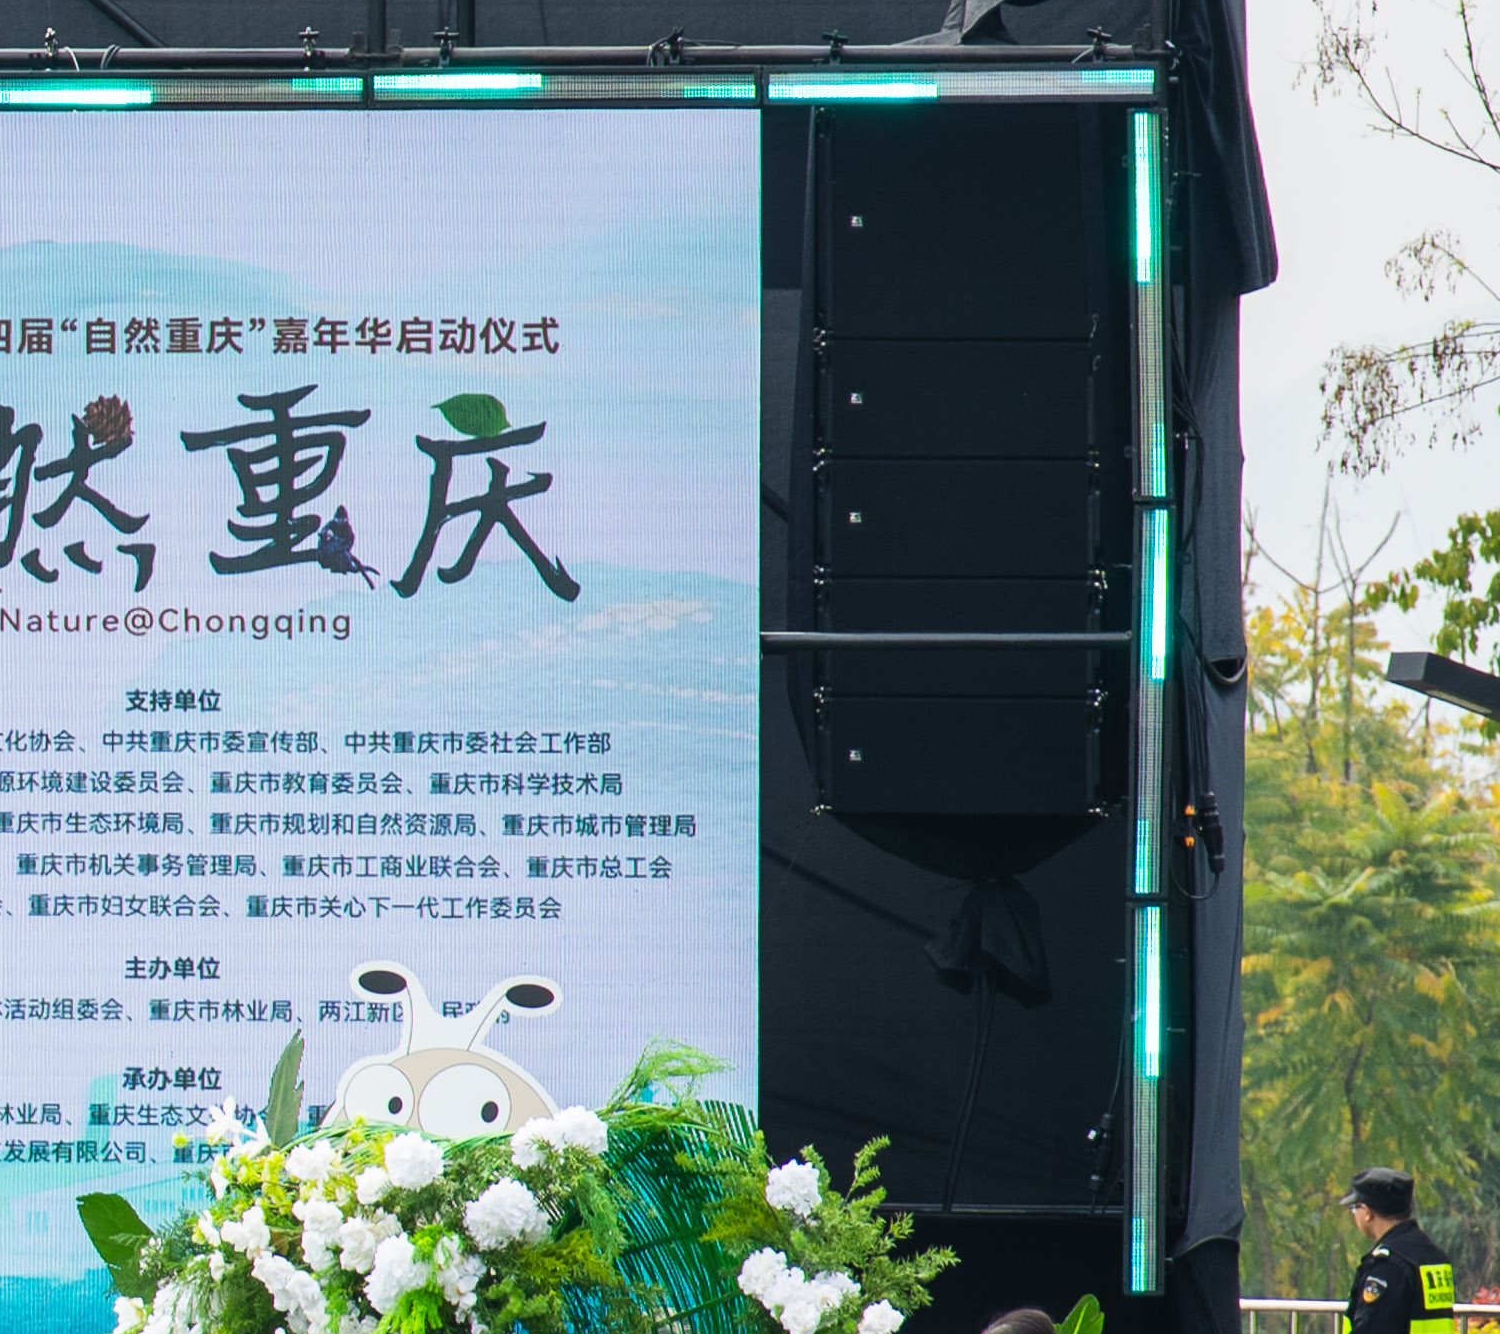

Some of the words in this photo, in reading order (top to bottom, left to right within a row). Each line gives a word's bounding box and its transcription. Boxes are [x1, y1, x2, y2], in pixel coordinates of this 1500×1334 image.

[0, 605, 353, 640] Nature@Chongqing
[125, 689, 222, 713] 支持单位
[124, 956, 221, 981] 主办单位
[121, 1067, 223, 1092] 承办单位
